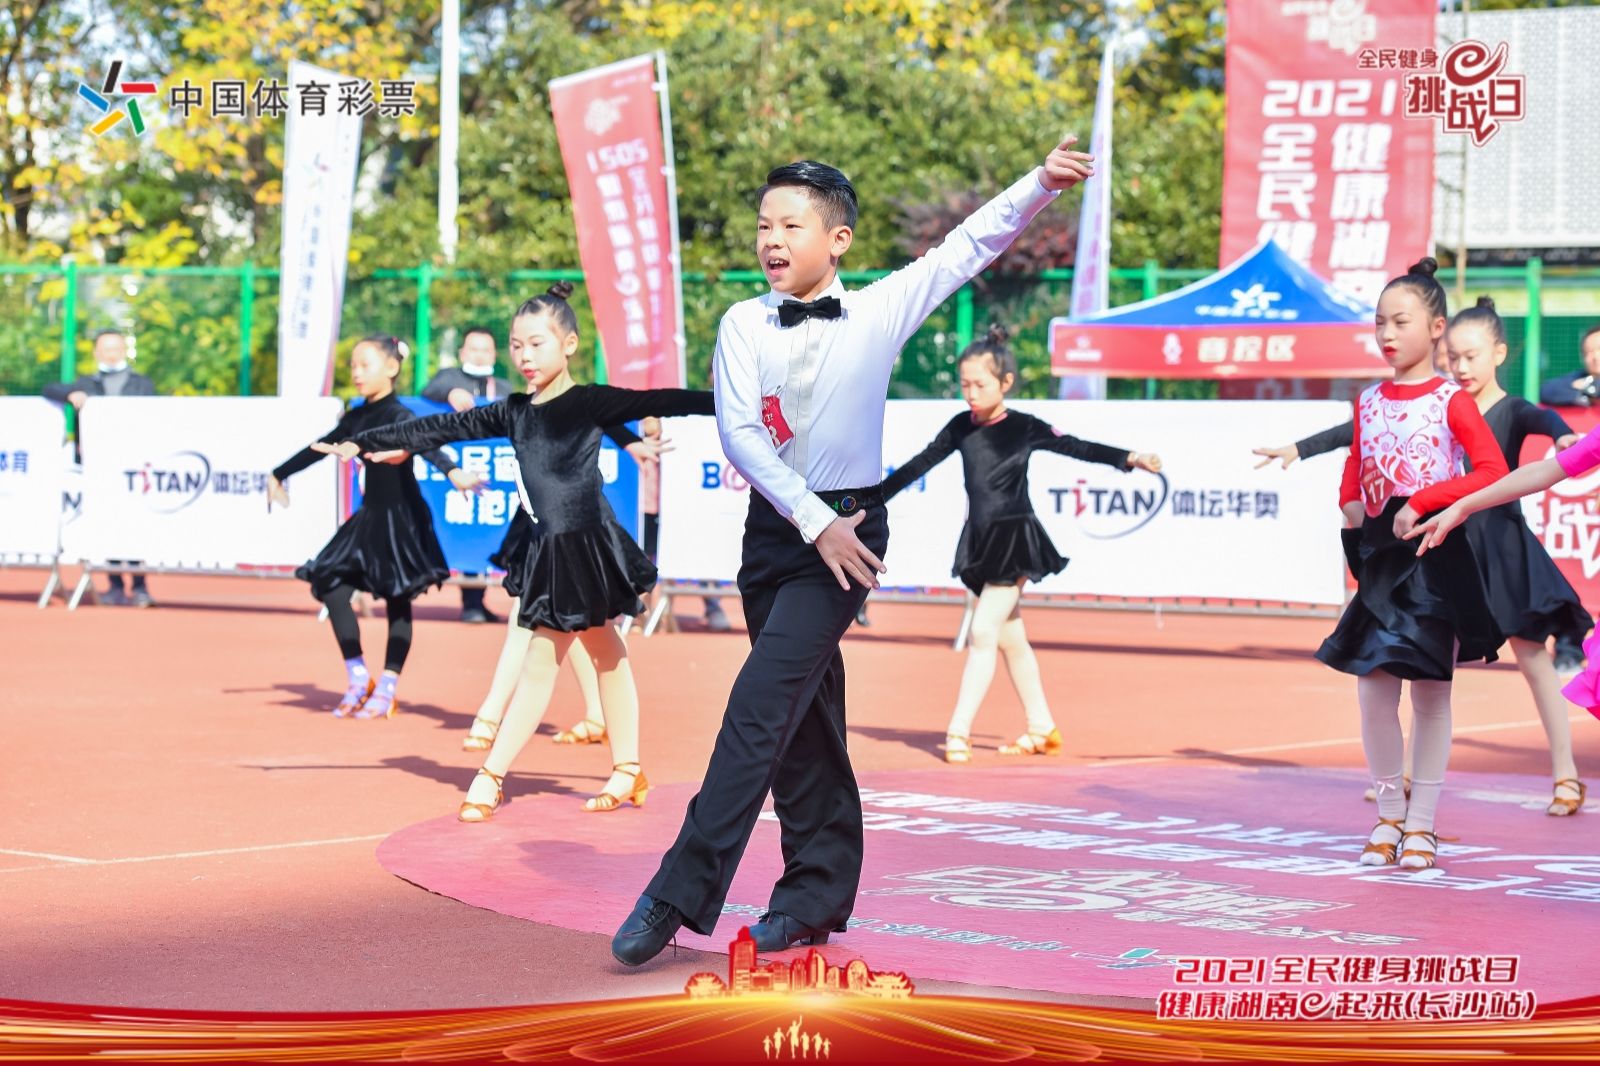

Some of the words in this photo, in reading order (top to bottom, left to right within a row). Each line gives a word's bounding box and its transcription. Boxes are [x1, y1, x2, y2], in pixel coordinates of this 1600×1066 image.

[1262, 79, 1398, 117] 2021
[212, 471, 290, 495] 体坛华
[1369, 477, 1386, 504] 17
[1171, 489, 1279, 519] 体坛华奥
